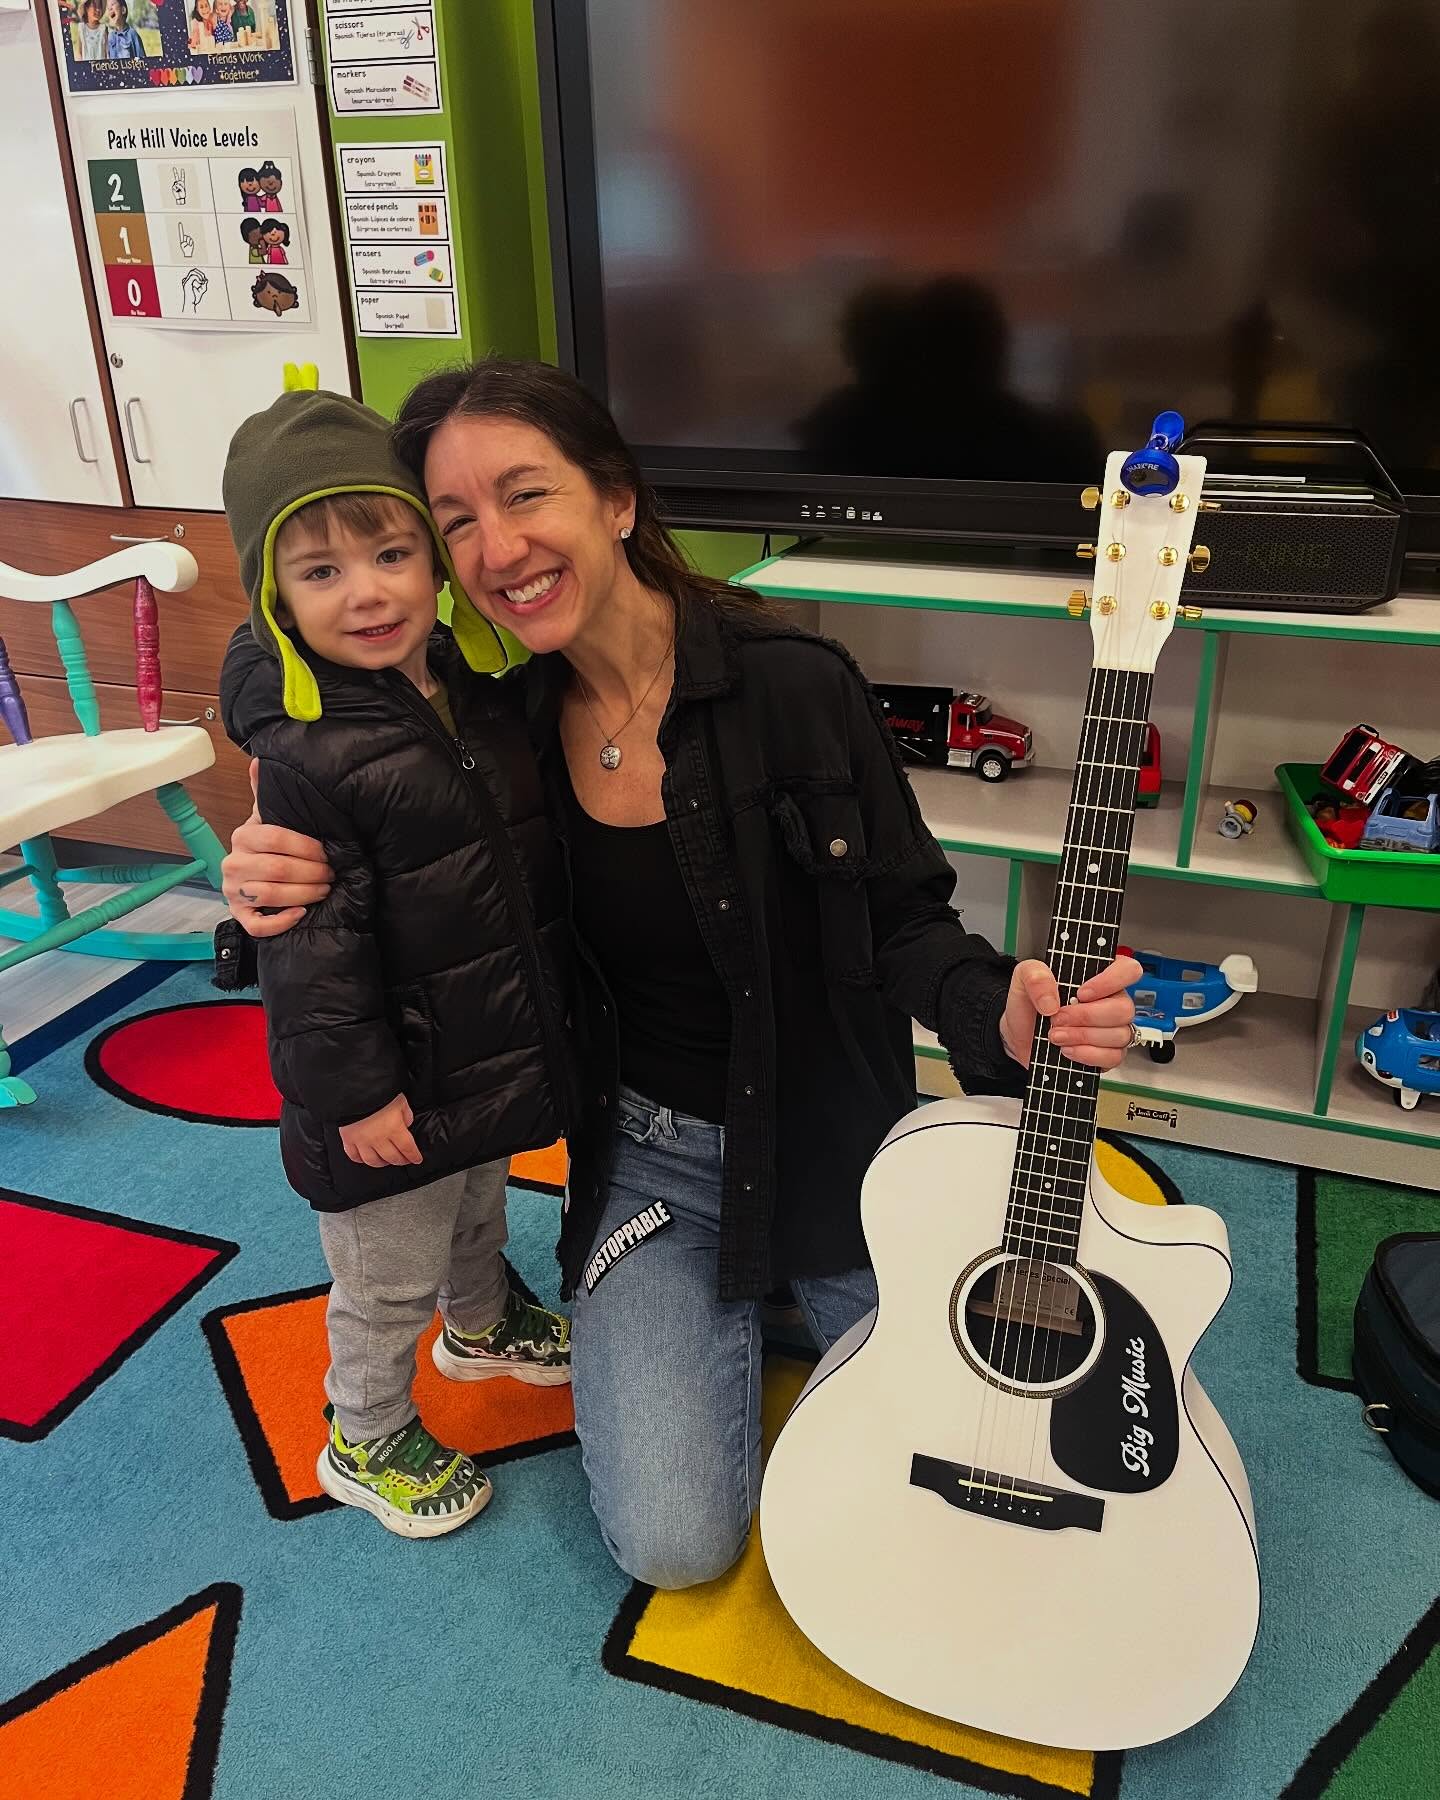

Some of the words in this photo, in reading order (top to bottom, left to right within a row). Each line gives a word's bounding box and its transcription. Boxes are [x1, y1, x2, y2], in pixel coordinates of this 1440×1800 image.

[335, 21, 364, 29] scissors
[90, 59, 118, 72] Friends
[119, 58, 145, 70] Listen
[207, 54, 237, 65] Friends
[238, 52, 265, 63] Work
[218, 69, 255, 81] Together
[337, 70, 367, 78] markers
[107, 128, 137, 149] Park
[140, 127, 166, 148] Hill
[169, 127, 208, 148] Voice
[213, 126, 259, 147] Levels
[347, 157, 376, 165] crayons
[108, 173, 124, 202] 2
[349, 203, 375, 211] colored
[376, 203, 399, 212] pencils
[119, 226, 131, 255] 1
[127, 279, 141, 307] 0
[585, 1200, 671, 1290] UNSTOPPABLE
[1121, 1336, 1152, 1419] Music
[377, 1445, 393, 1463] MGO
[1120, 1424, 1155, 1478] Big
